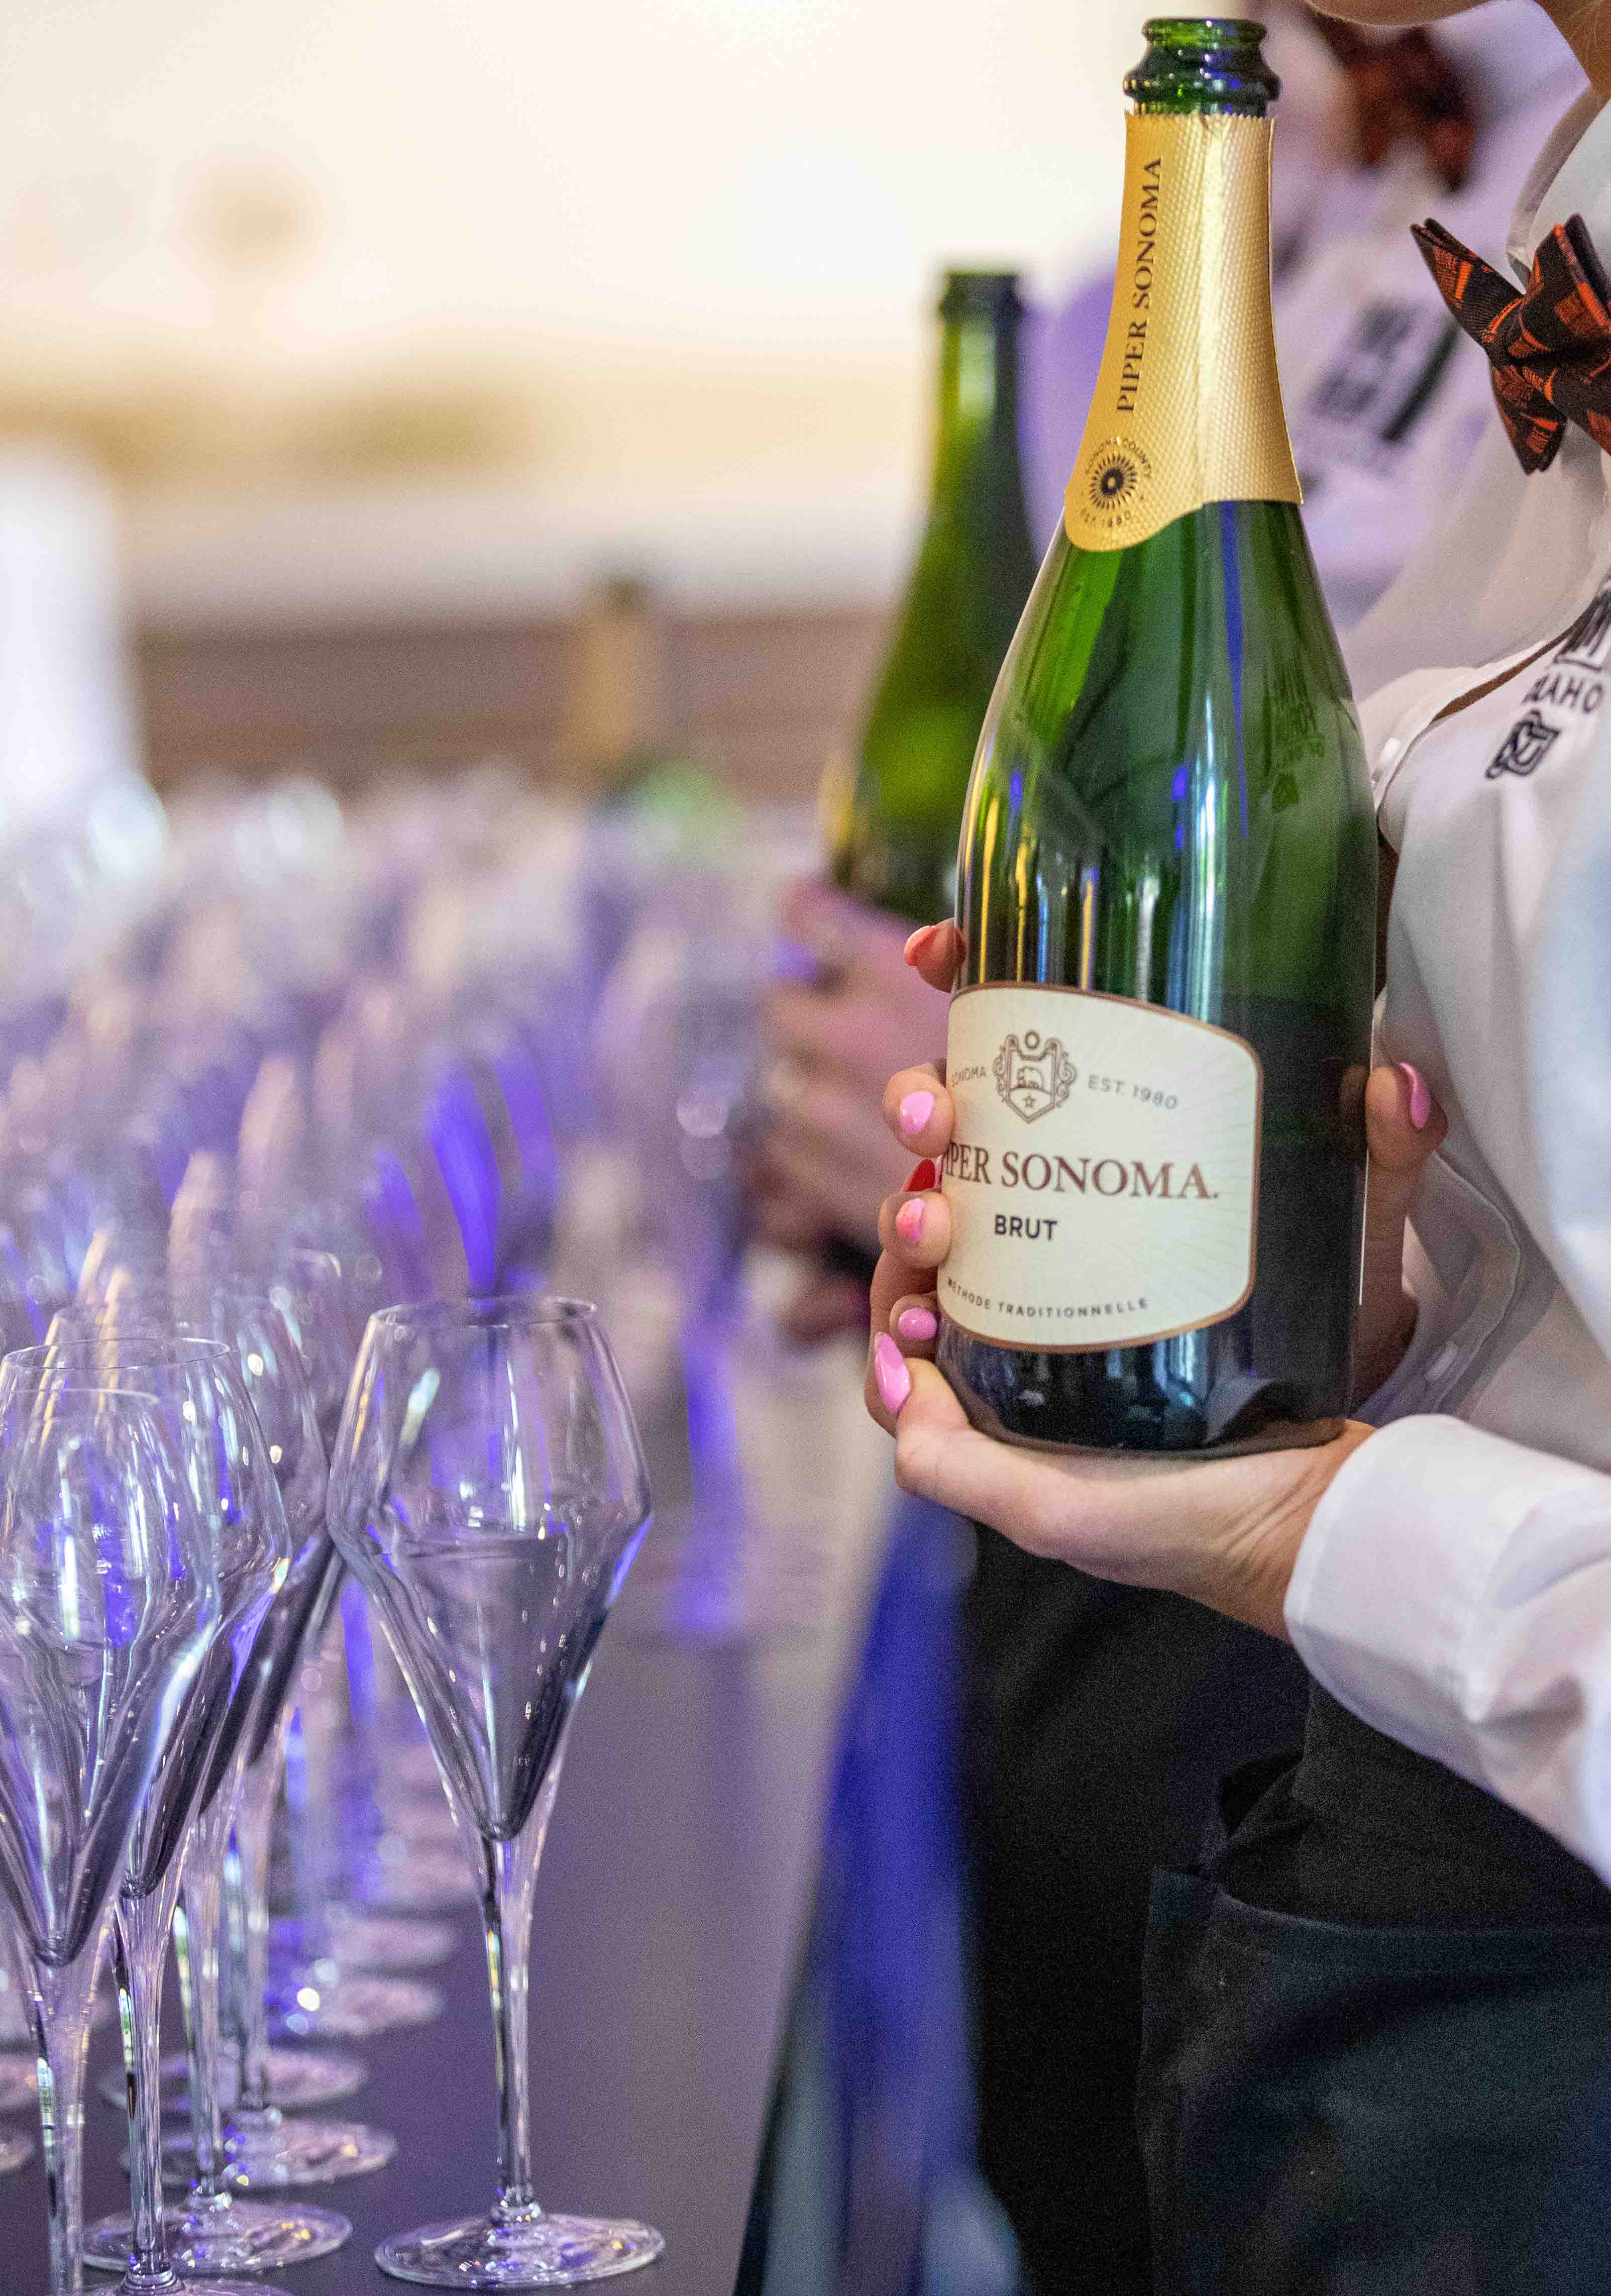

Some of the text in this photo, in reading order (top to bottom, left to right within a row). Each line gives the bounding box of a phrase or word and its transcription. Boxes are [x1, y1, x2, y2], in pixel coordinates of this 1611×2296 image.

[1117, 157, 1161, 412] PIPER SONOMA
[1133, 1084, 1178, 1110] 1980
[995, 1214, 1057, 1240] BRUT
[998, 1297, 1148, 1319] TRADITIONNELLE
